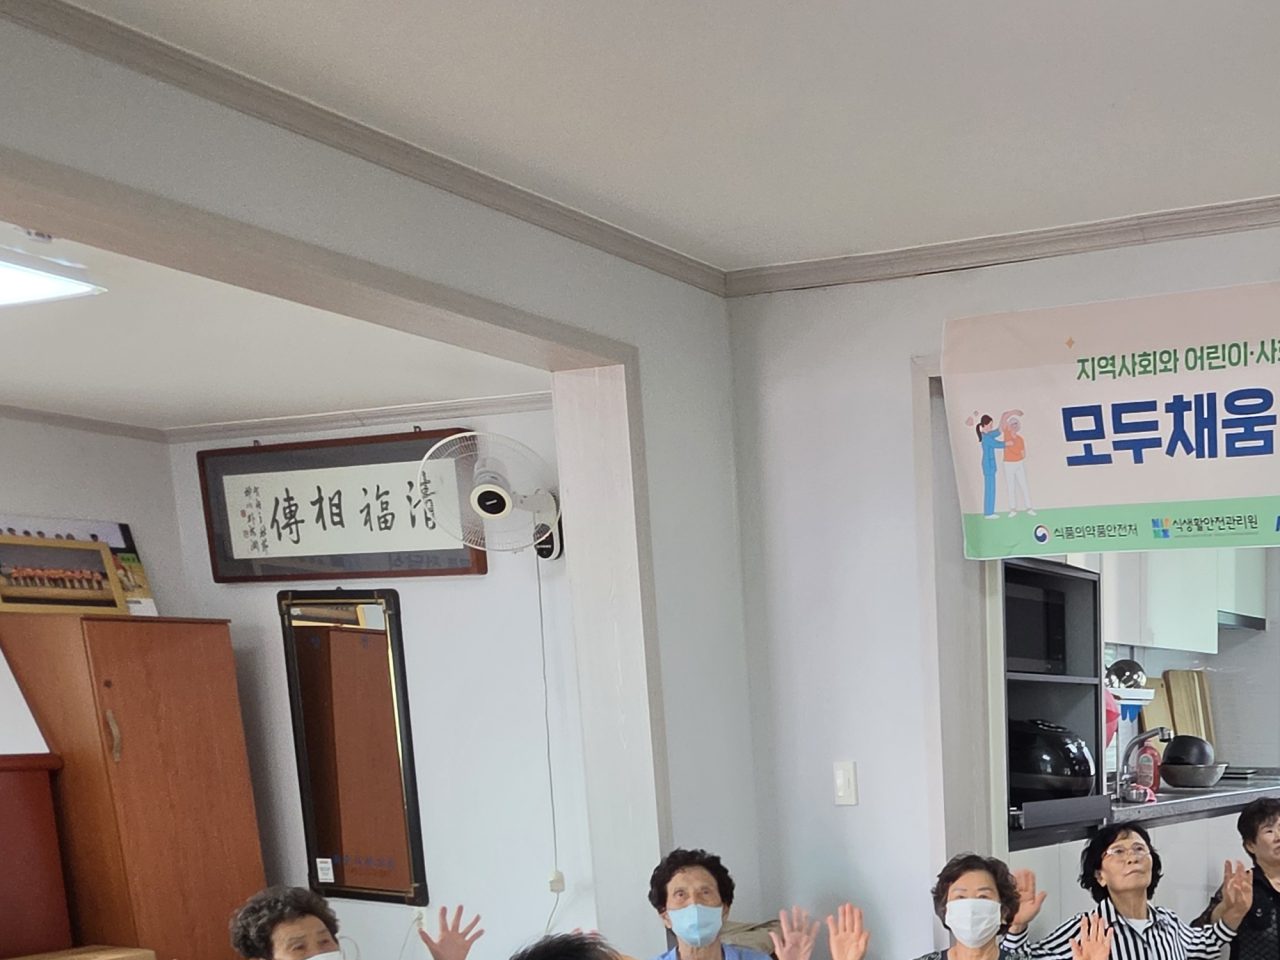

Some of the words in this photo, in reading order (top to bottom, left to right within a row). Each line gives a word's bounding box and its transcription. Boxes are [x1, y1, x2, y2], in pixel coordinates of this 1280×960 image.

[1076, 349, 1179, 381] 지역사회와
[1062, 387, 1278, 467] 모두채움
[1053, 523, 1139, 541] 식품의약품안전처
[1172, 514, 1260, 534] 식생활안전관리원
